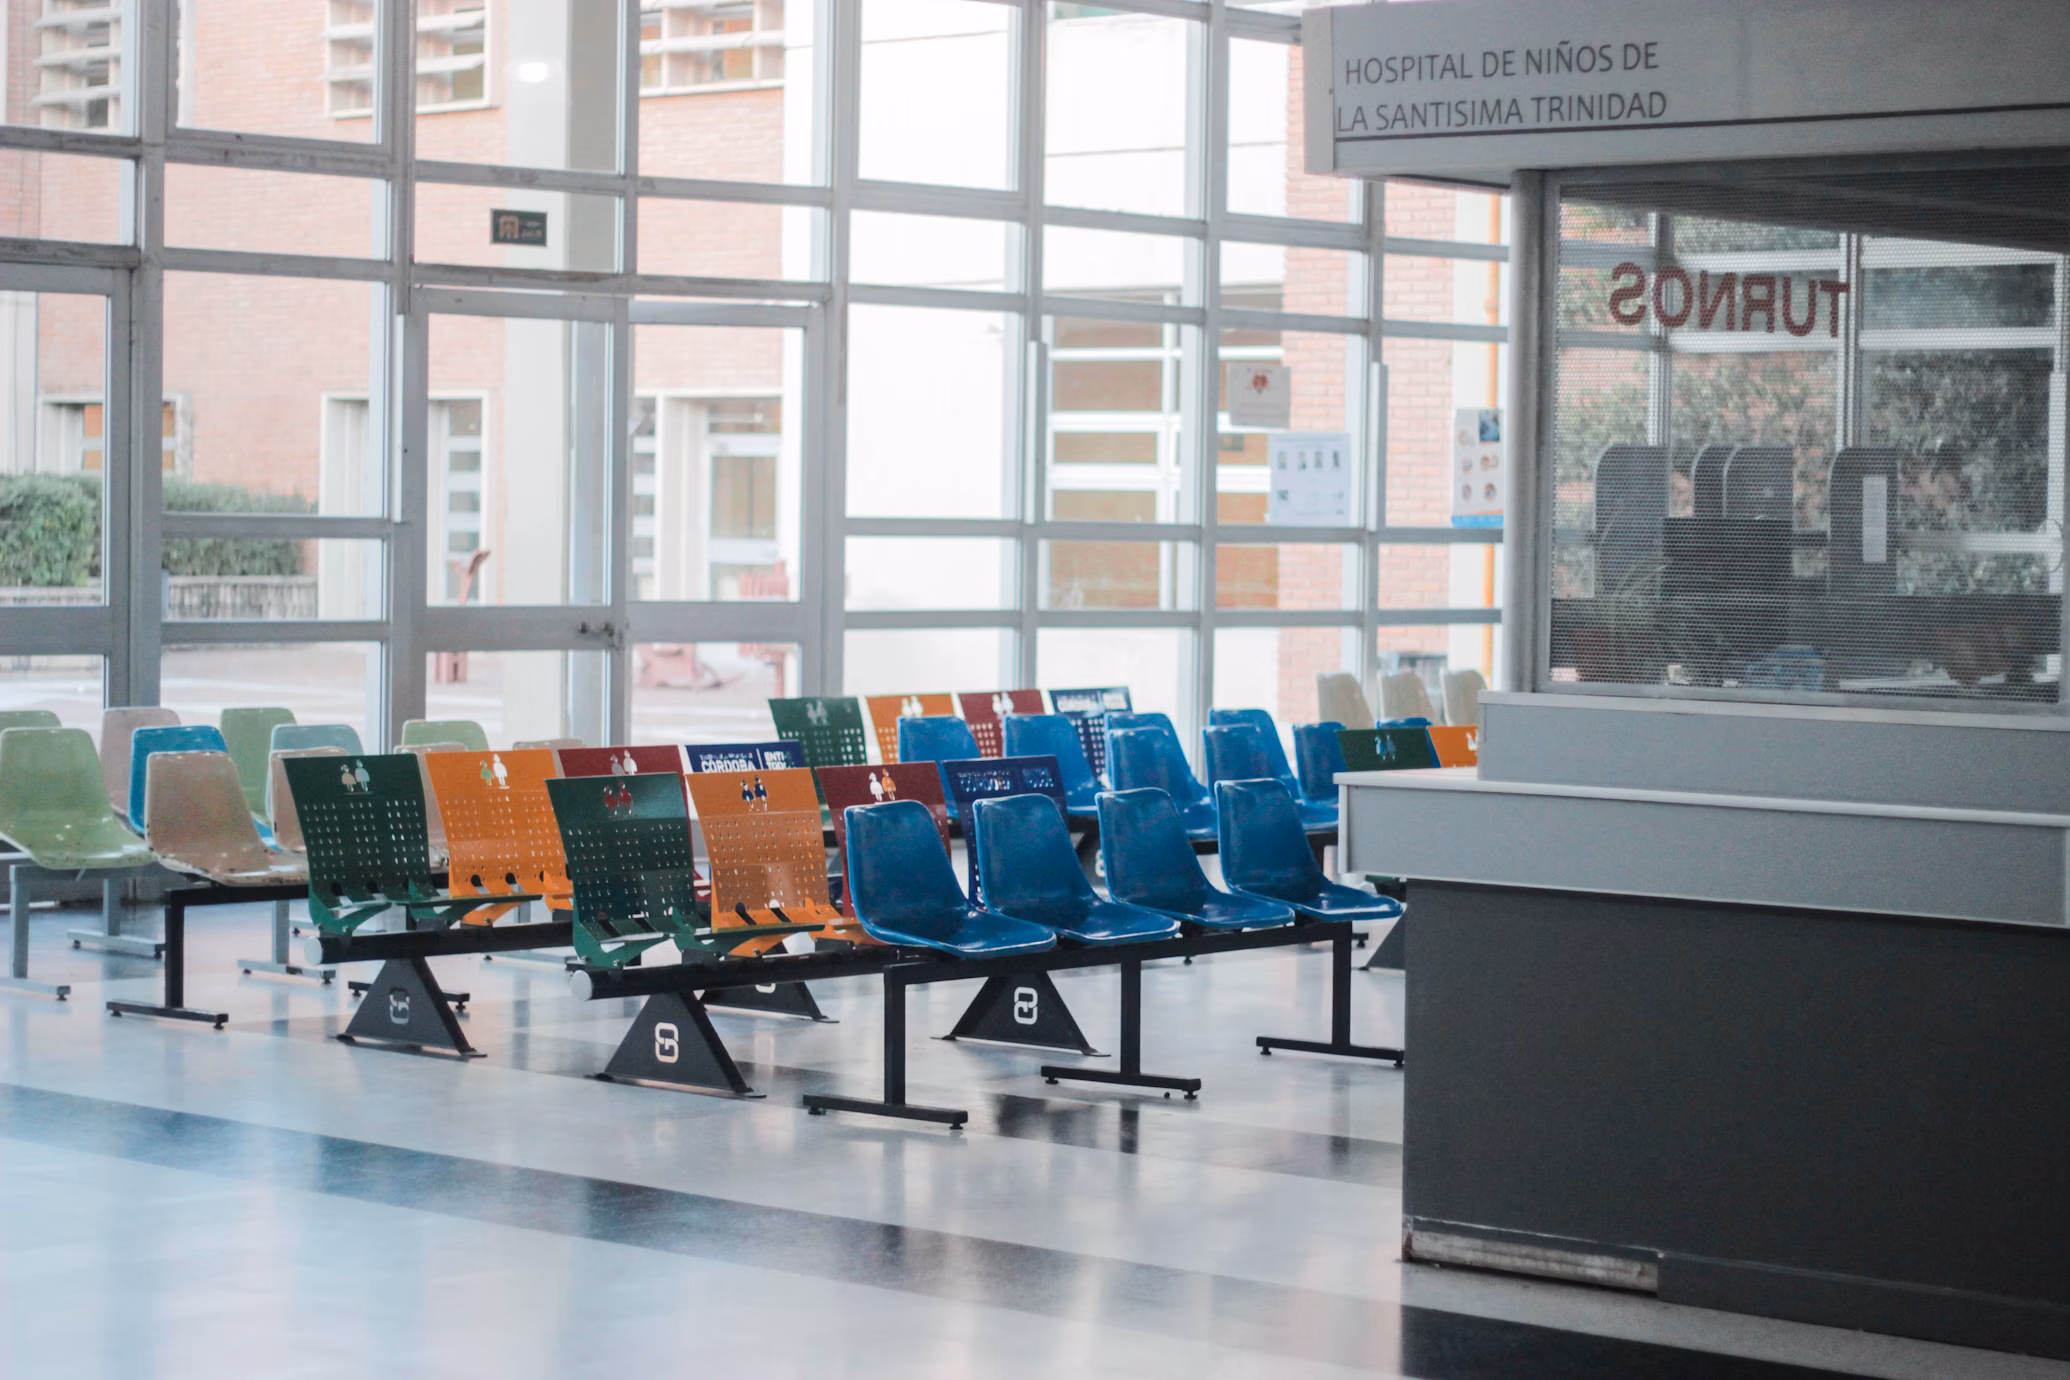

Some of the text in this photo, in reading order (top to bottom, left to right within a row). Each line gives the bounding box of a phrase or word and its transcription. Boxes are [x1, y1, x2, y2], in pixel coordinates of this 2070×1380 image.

[1345, 40, 1659, 85] HOSPITAL DE NIÑOS DE
[1337, 91, 1667, 132] LA SANTISIMA TRINIDAD
